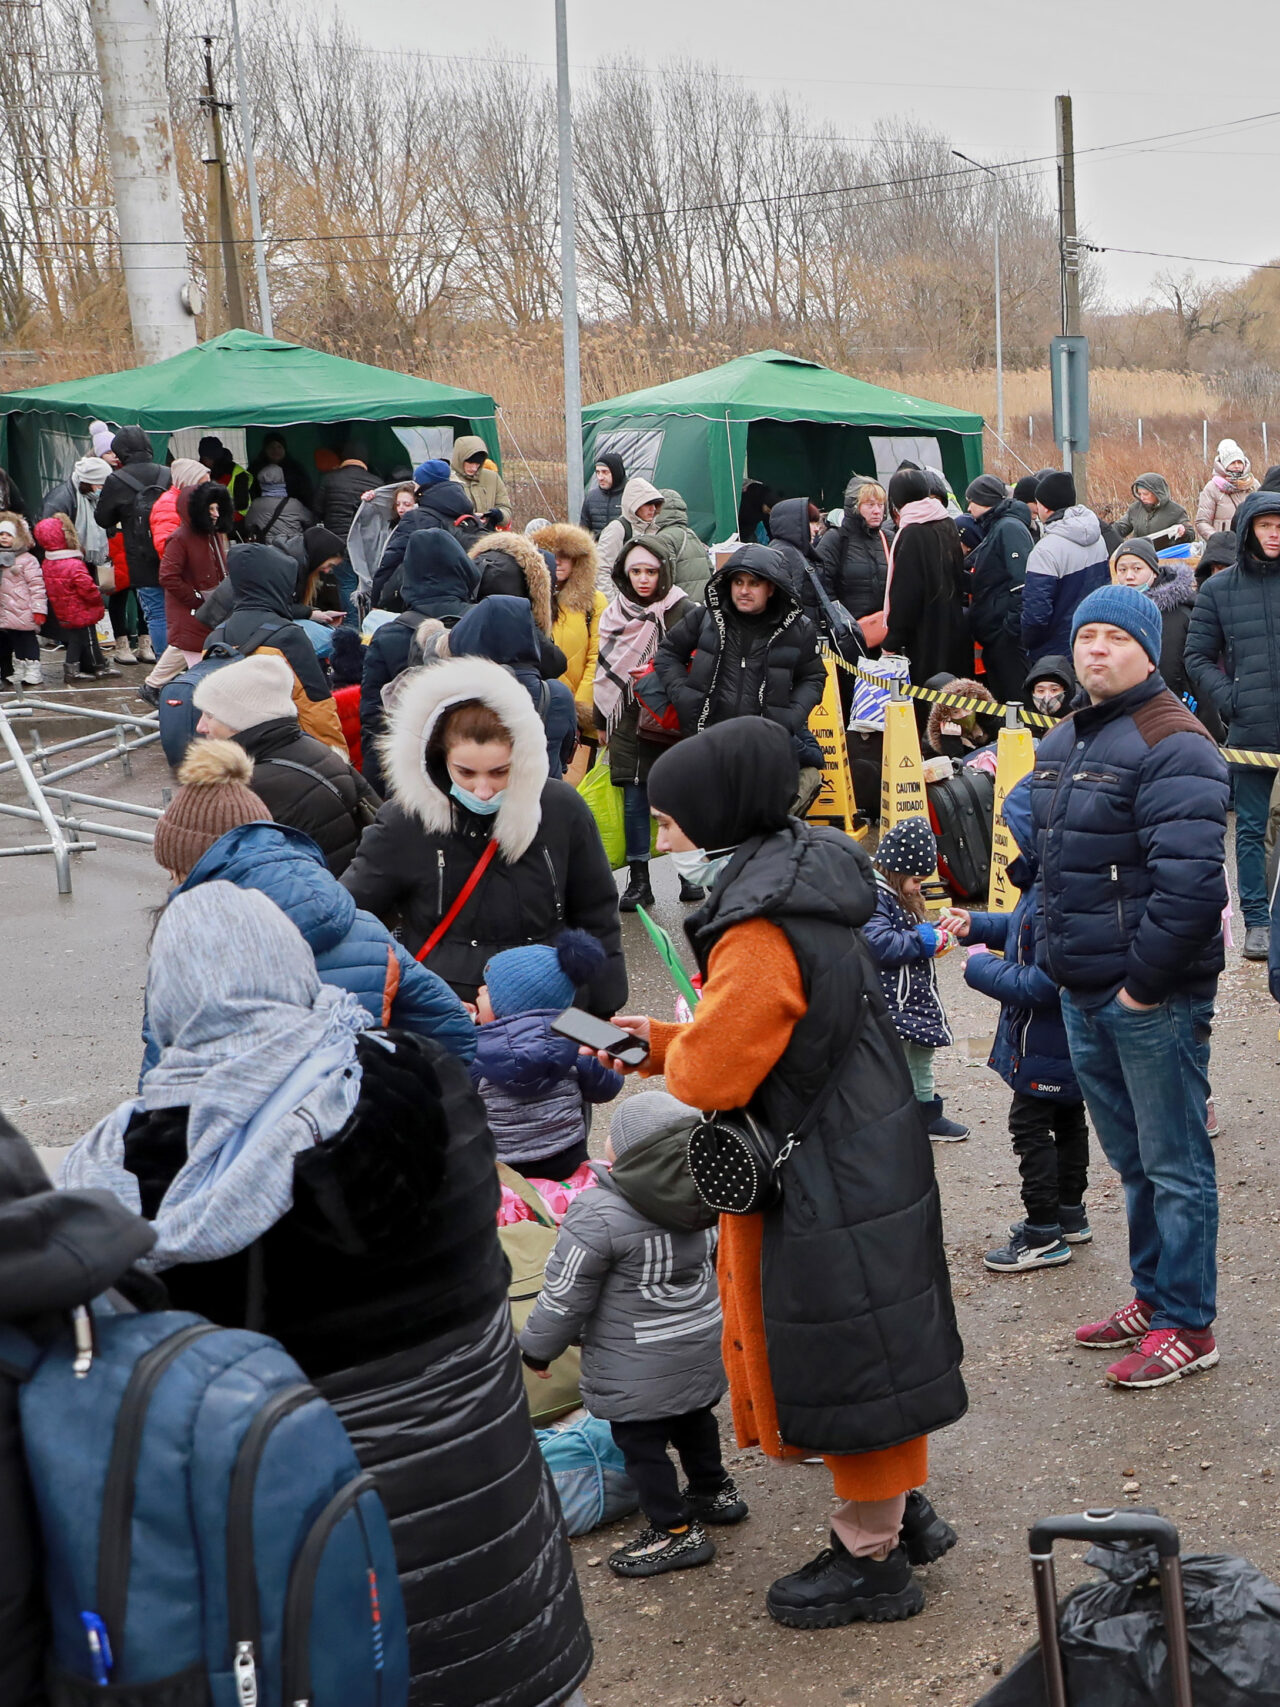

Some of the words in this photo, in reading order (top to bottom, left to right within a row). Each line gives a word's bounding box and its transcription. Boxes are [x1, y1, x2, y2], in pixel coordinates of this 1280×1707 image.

[697, 698, 710, 735] MONCLE
[896, 782, 921, 794] CAUTION
[896, 800, 924, 812] CUIDADO
[1038, 1084, 1061, 1092] SNOW
